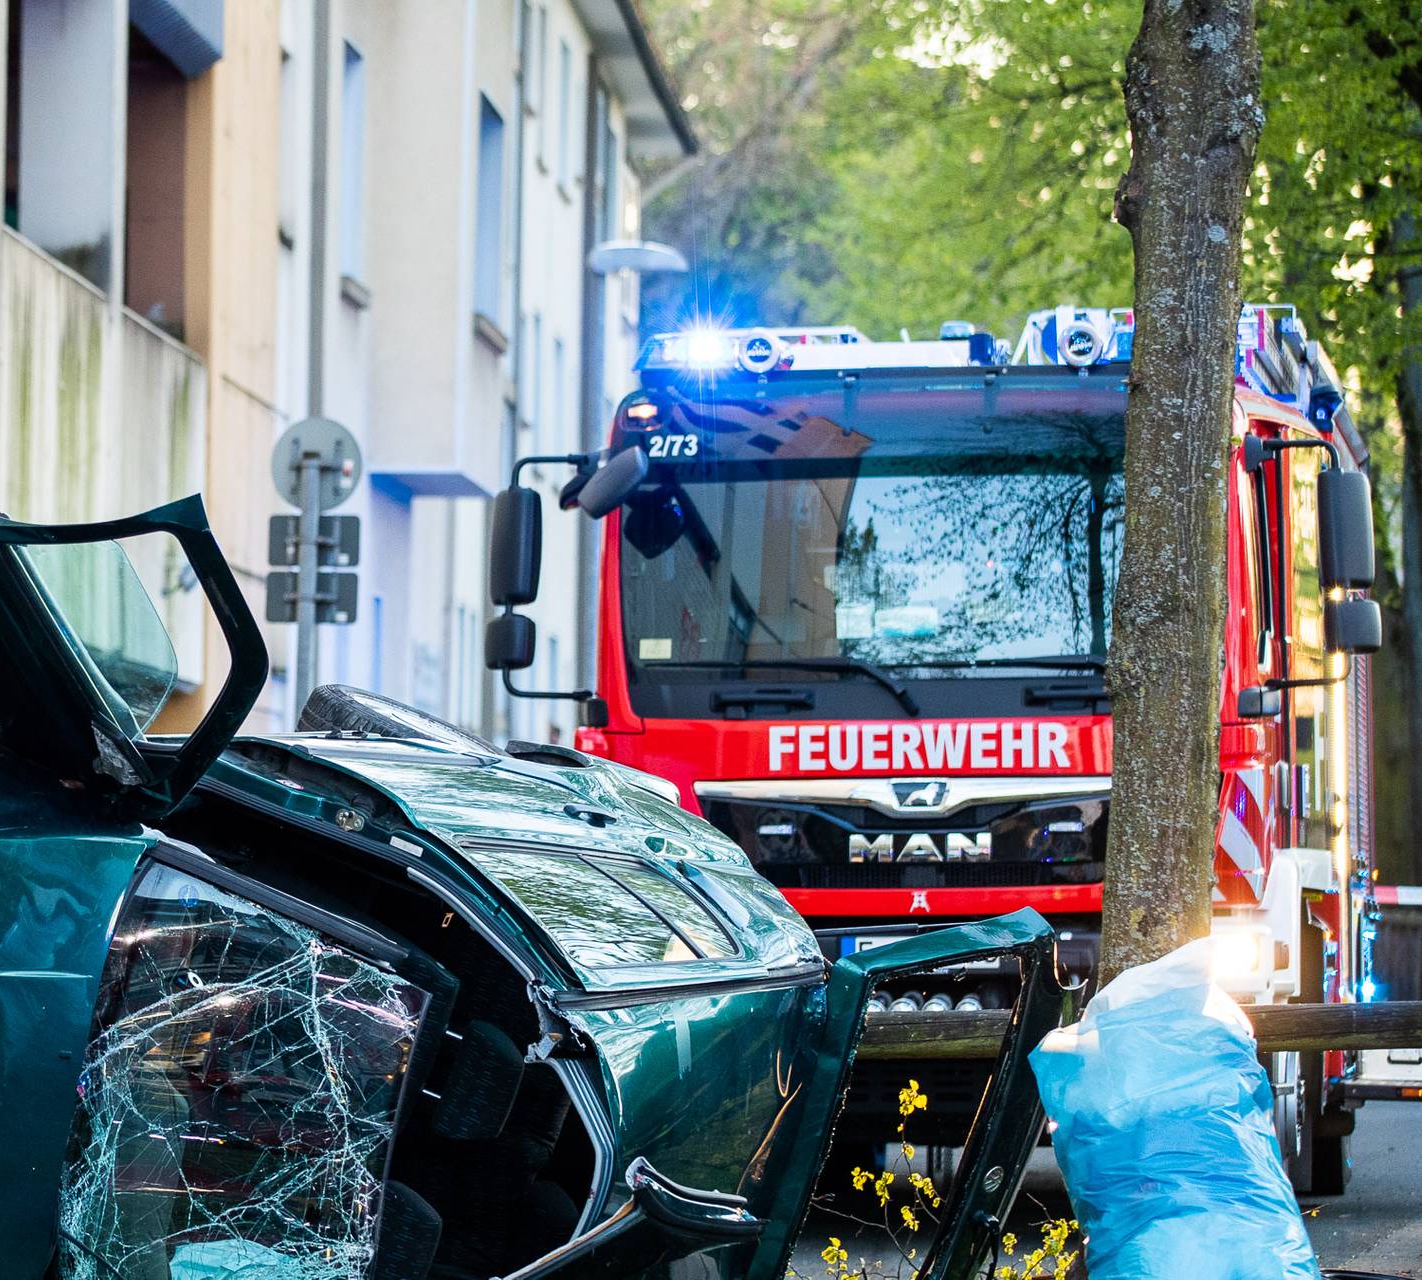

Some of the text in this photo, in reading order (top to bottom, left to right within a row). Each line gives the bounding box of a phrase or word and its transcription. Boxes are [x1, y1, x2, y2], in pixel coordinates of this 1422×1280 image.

[649, 434, 698, 457] 2/73
[769, 722, 1071, 771] FEUERWEHR
[849, 833, 992, 862] MAN
